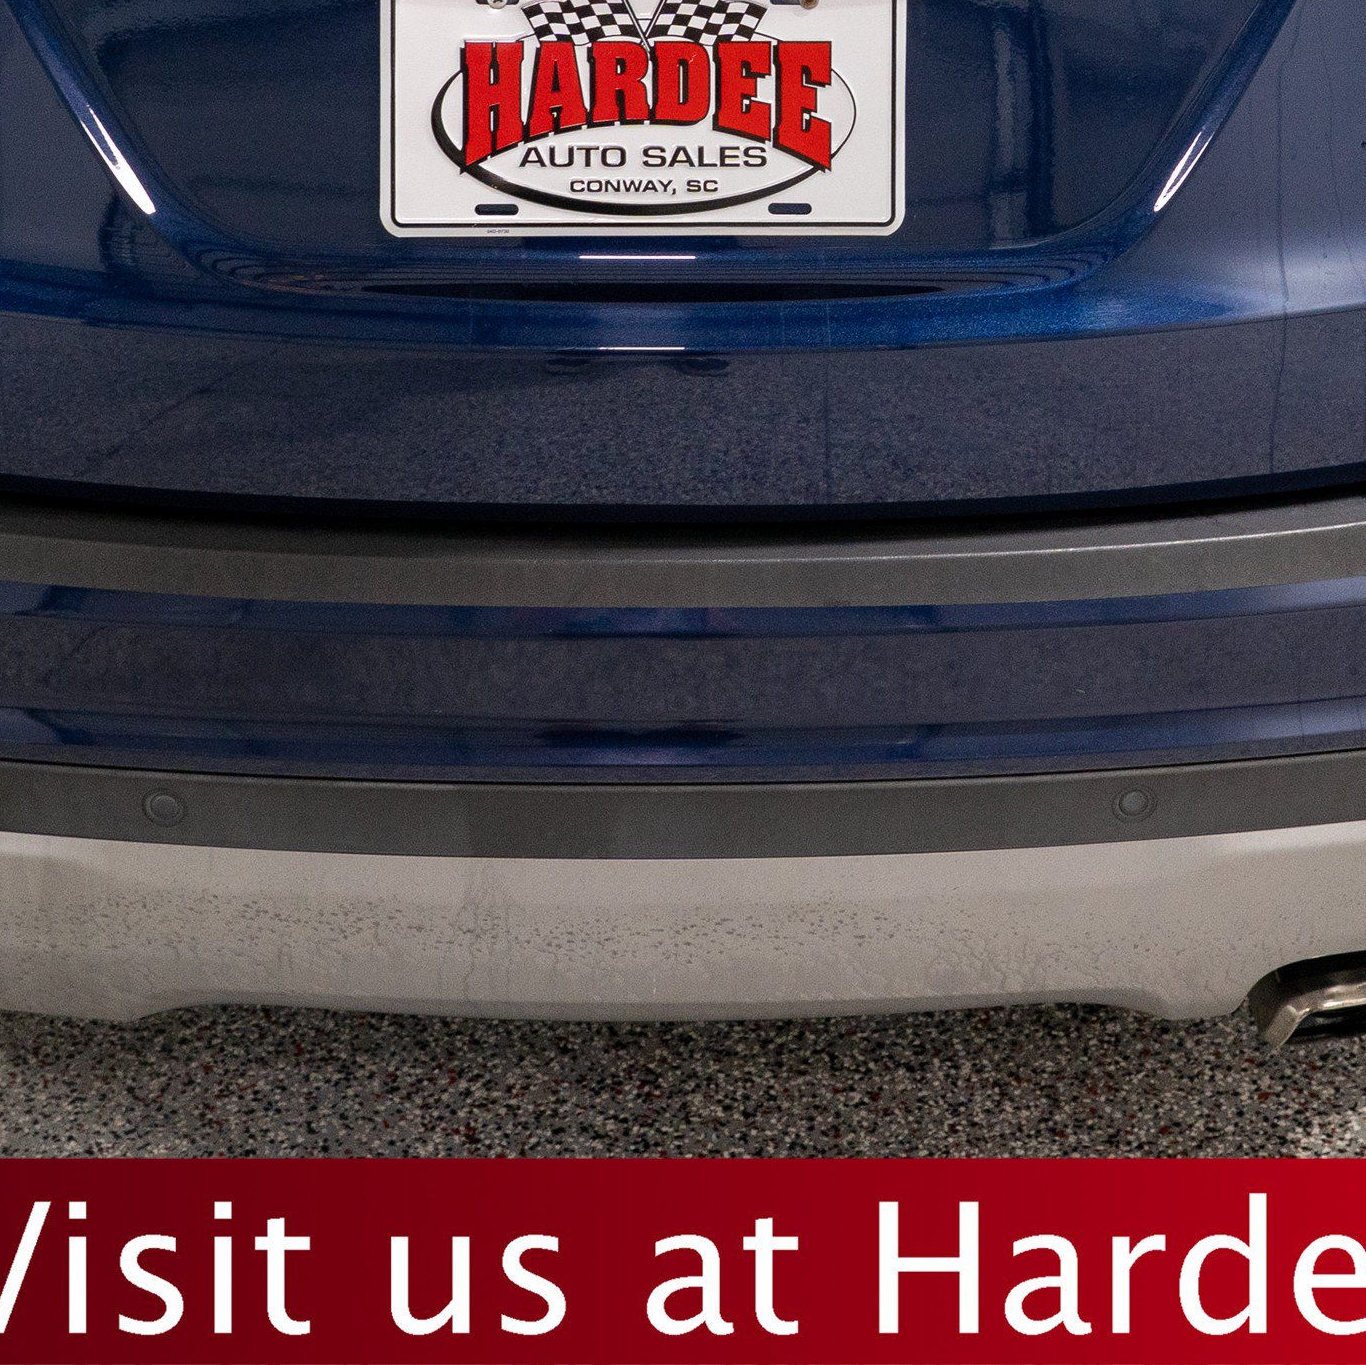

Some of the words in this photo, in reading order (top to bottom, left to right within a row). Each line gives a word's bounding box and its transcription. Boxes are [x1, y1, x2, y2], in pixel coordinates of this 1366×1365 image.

[460, 39, 833, 174] HARDEE
[519, 145, 627, 168] AUTO
[642, 145, 768, 168] SALES
[569, 178, 677, 196] CONWAY,
[687, 179, 719, 193] SC
